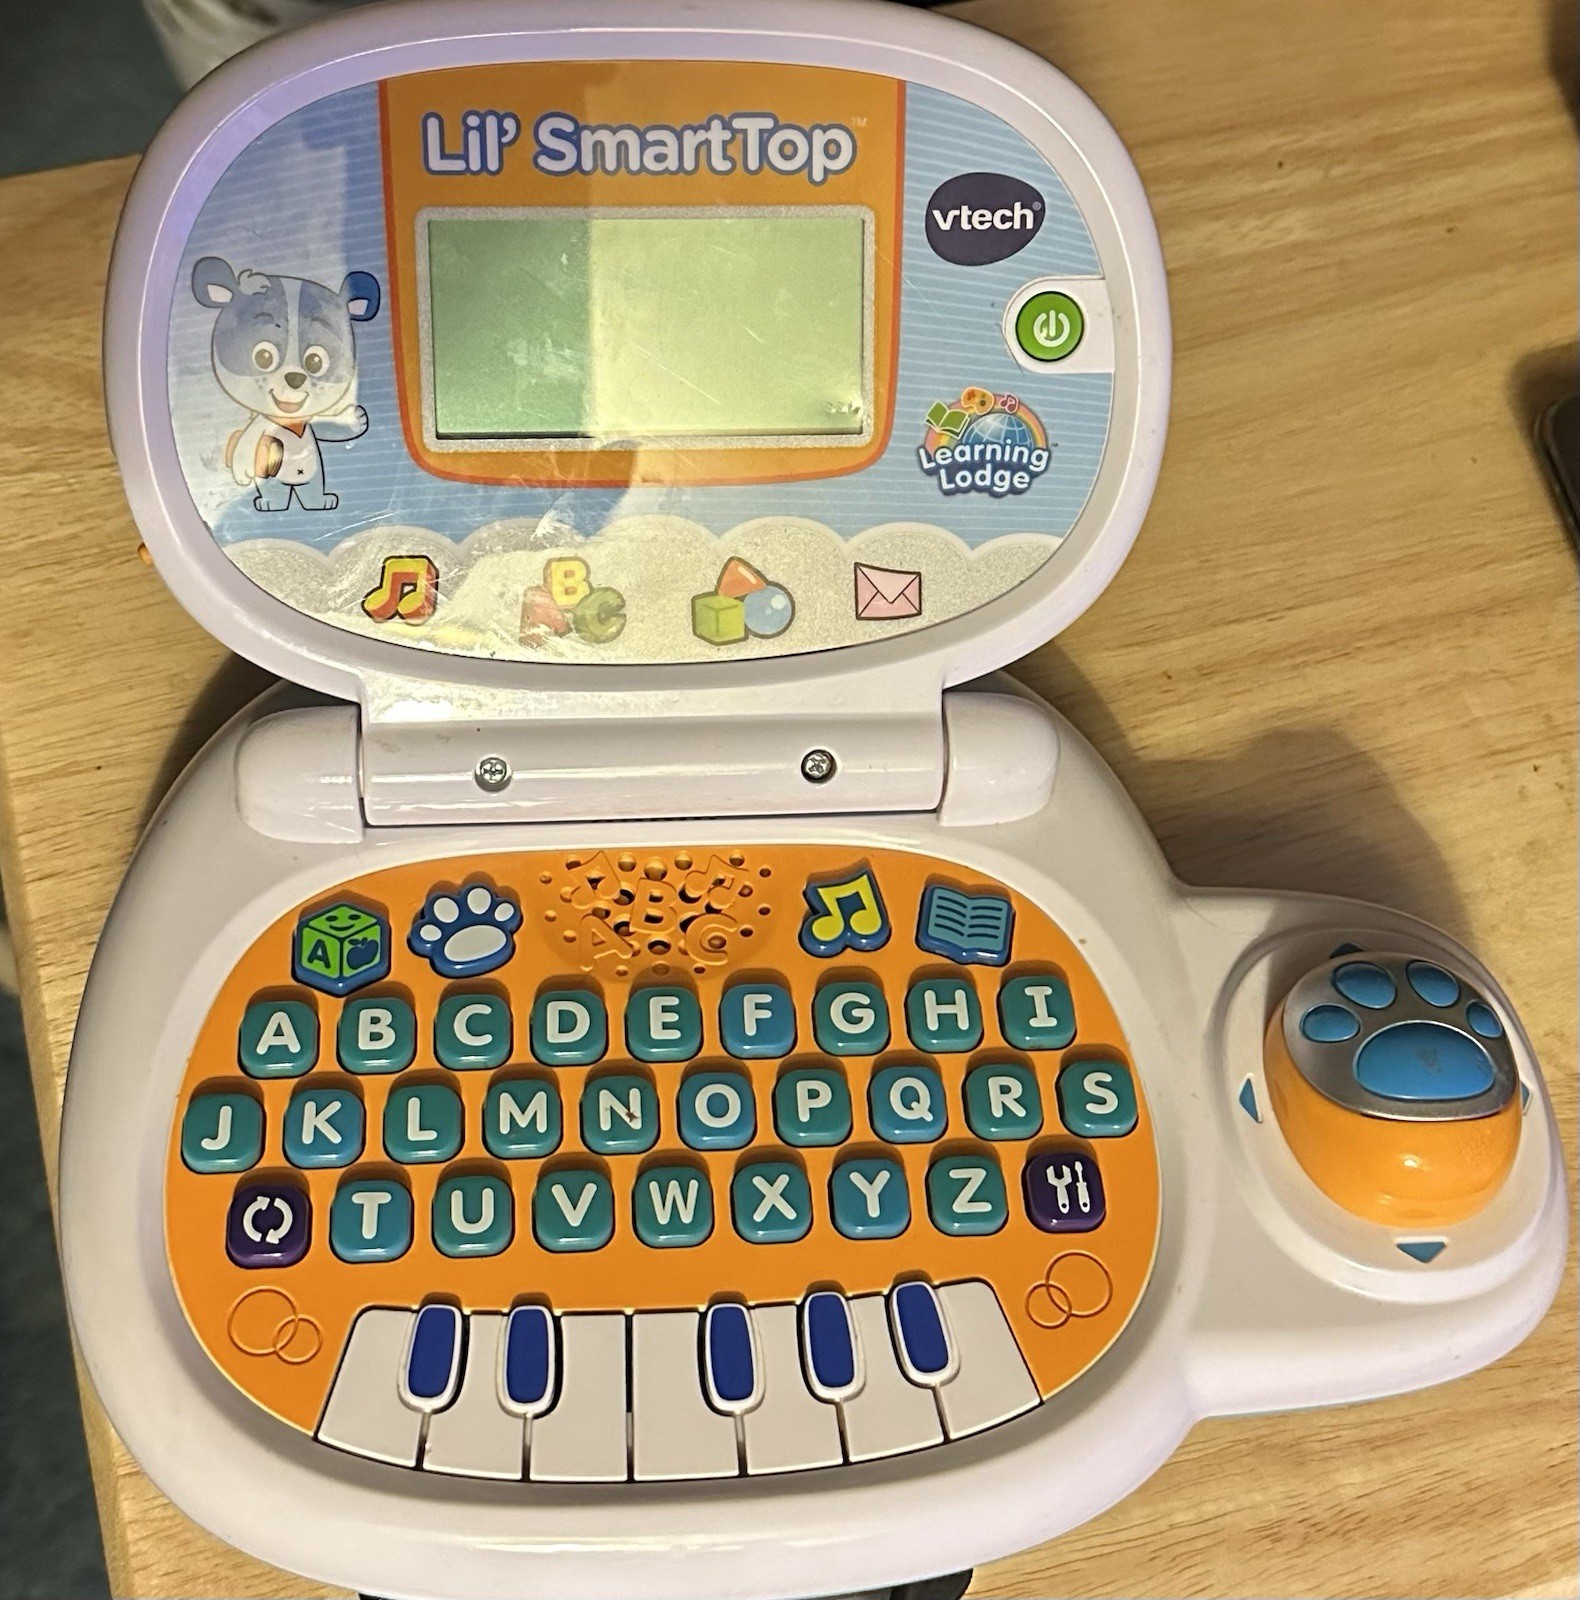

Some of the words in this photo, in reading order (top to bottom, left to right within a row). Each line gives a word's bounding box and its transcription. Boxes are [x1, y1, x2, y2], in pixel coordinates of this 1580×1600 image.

[423, 112, 519, 174] Lil’
[534, 113, 856, 184] SmartTop
[932, 201, 1035, 231] vtech
[918, 439, 1050, 472] Learning
[939, 463, 1031, 493] Lodge
[306, 940, 333, 972] A
[255, 1011, 301, 1056] A
[357, 1008, 396, 1051] B
[453, 1003, 493, 1047] C
[546, 1000, 591, 1044] D
[649, 996, 682, 1040] E
[743, 993, 773, 1037] F
[829, 992, 876, 1035] G
[923, 989, 970, 1032] H
[1024, 985, 1058, 1028] I
[200, 1105, 233, 1151] J
[301, 1100, 342, 1145] K
[407, 1096, 438, 1142] L
[499, 1090, 548, 1135] M
[598, 1087, 643, 1132] N
[694, 1083, 741, 1129] O
[796, 1080, 833, 1123] P
[889, 1077, 934, 1122] Q
[987, 1076, 1027, 1119] R
[1083, 1072, 1119, 1115] S
[351, 1191, 392, 1240] T
[450, 1187, 495, 1235] U
[551, 1182, 598, 1228] V
[648, 1179, 699, 1225] W
[752, 1173, 797, 1223] X
[849, 1169, 891, 1219] Y
[948, 1167, 993, 1214] Z
